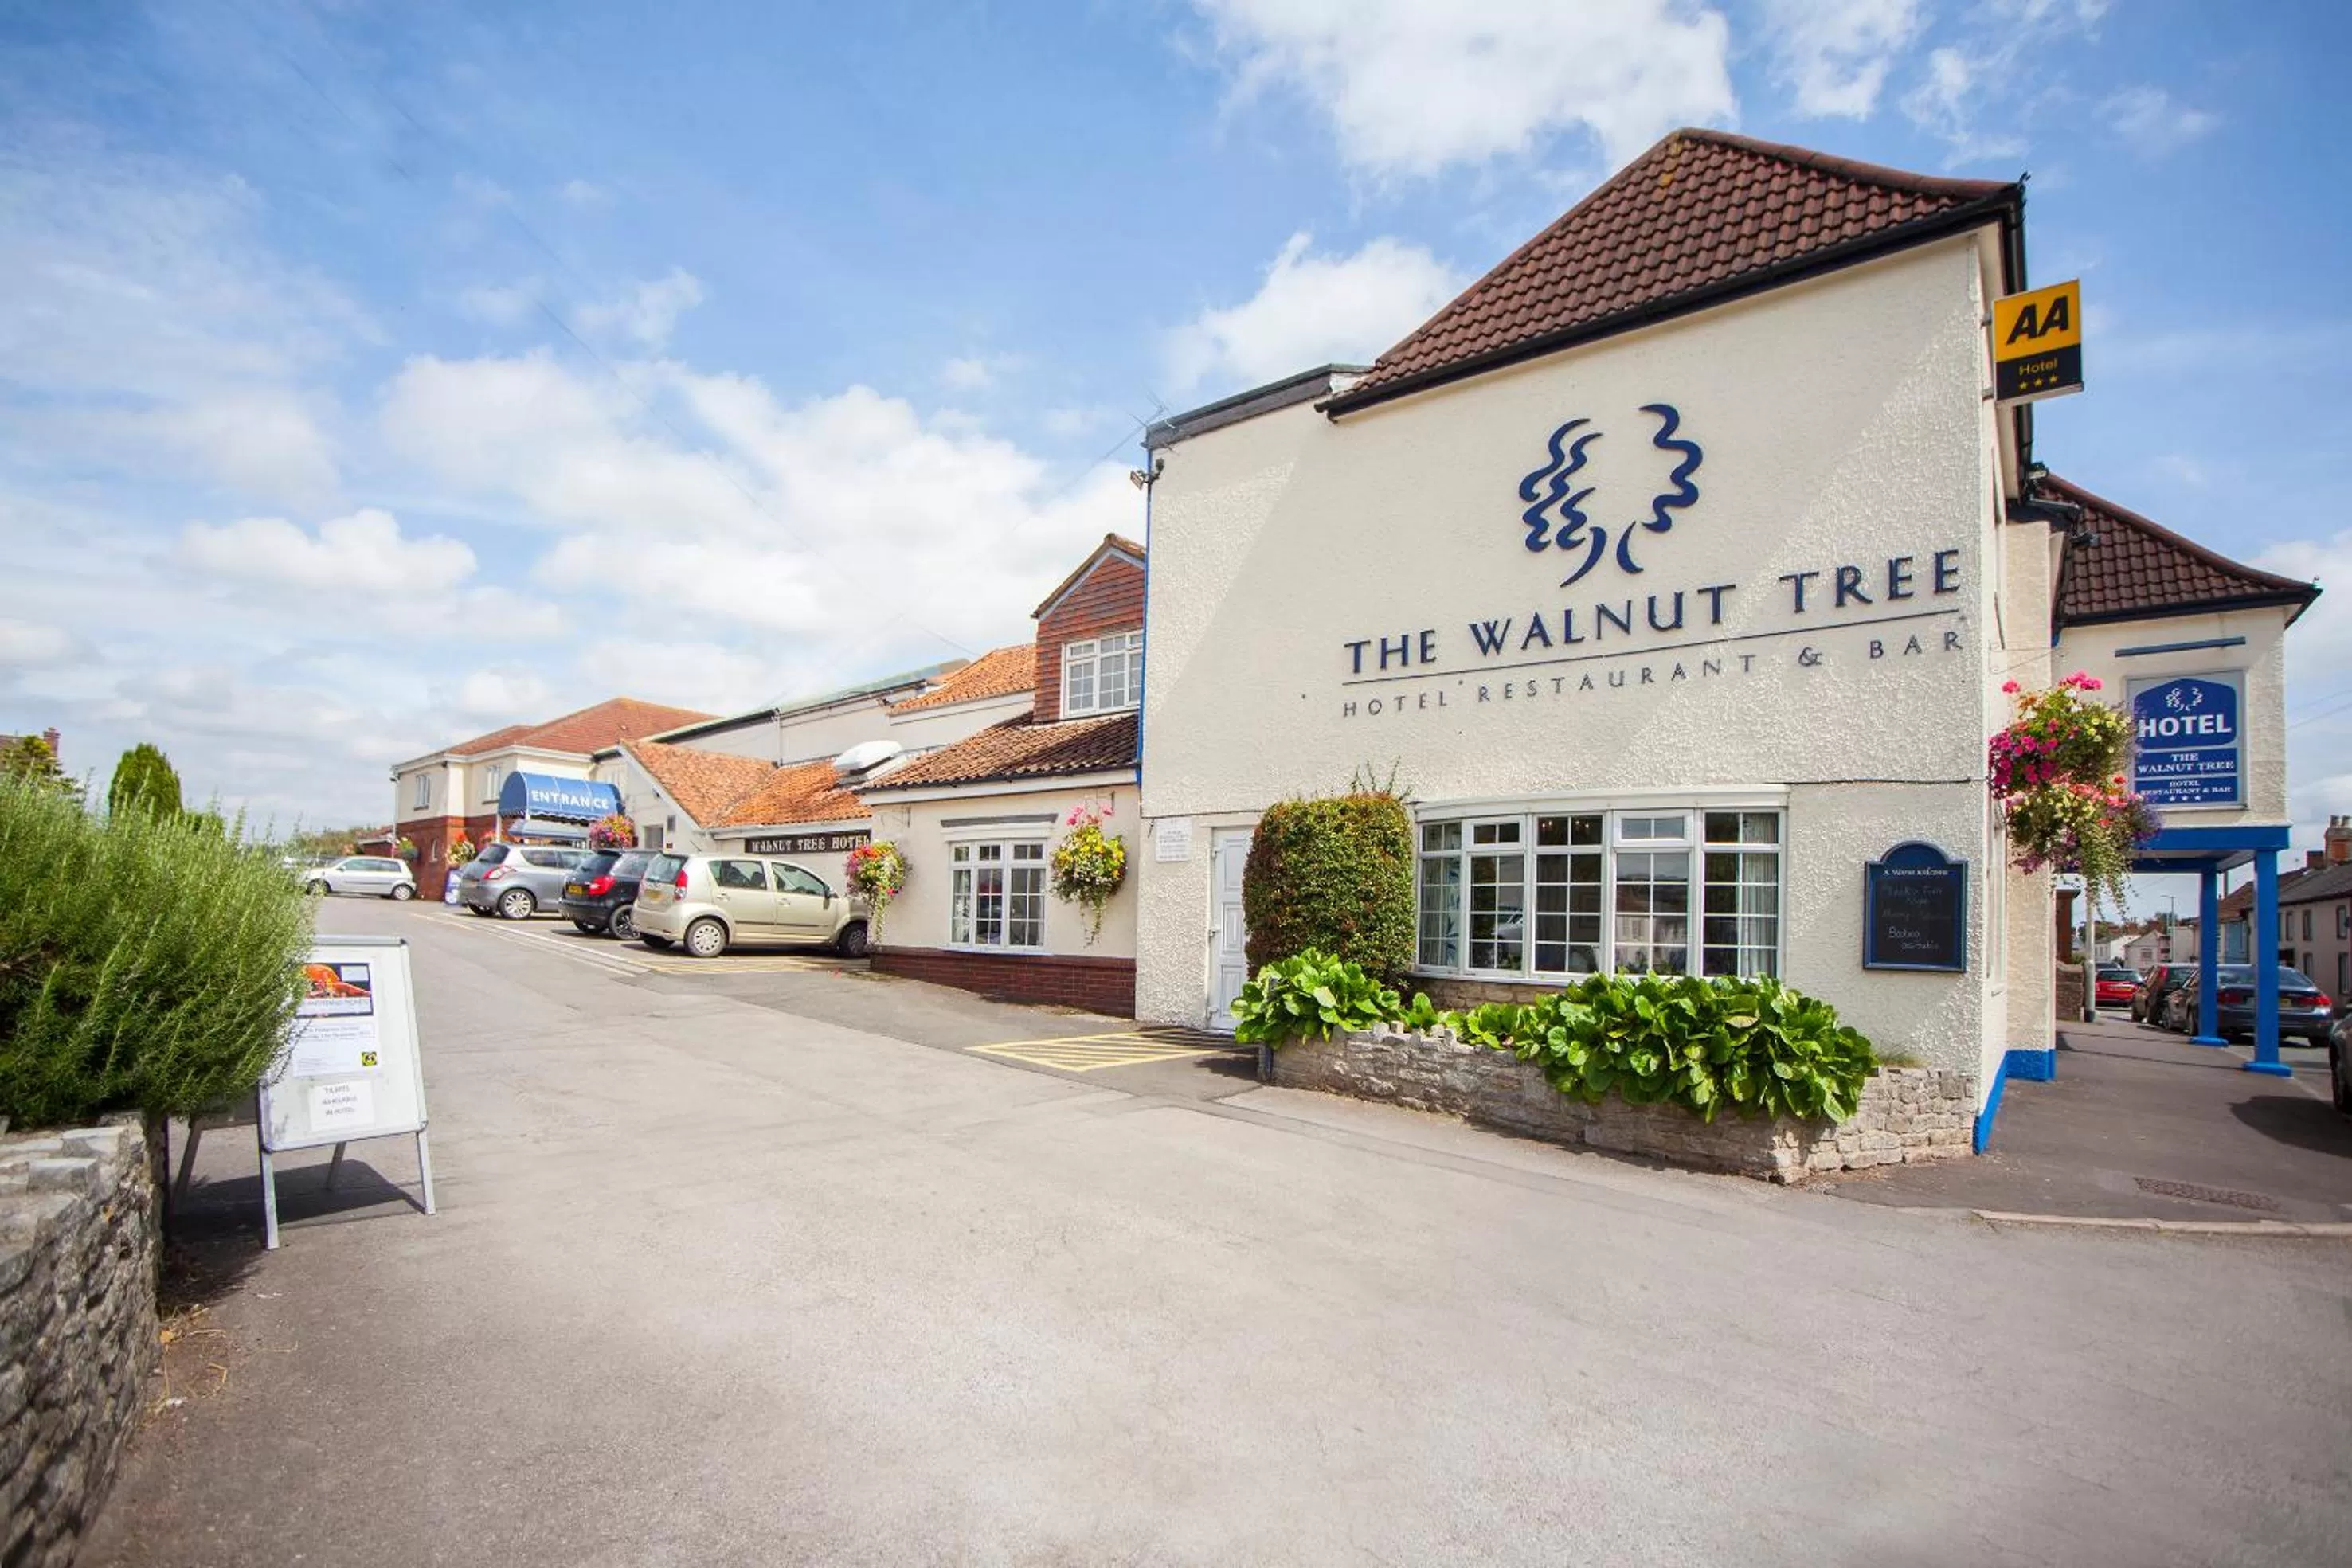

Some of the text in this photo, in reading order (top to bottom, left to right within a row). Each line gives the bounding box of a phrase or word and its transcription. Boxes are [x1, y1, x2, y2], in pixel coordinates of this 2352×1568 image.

[2006, 295, 2069, 345] AA
[2019, 358, 2058, 375] Hotel
[1344, 549, 1961, 673] THE WALNUT TREE
[1343, 632, 1963, 718] HOTEL RESTAURANT & BAR
[2137, 714, 2232, 738] HOTEL
[2137, 761, 2234, 773] WALNUT TREE
[2170, 753, 2199, 762] THE
[530, 789, 609, 810] ENTRANCE
[751, 839, 792, 852] WALNUT
[797, 837, 826, 850] TREE
